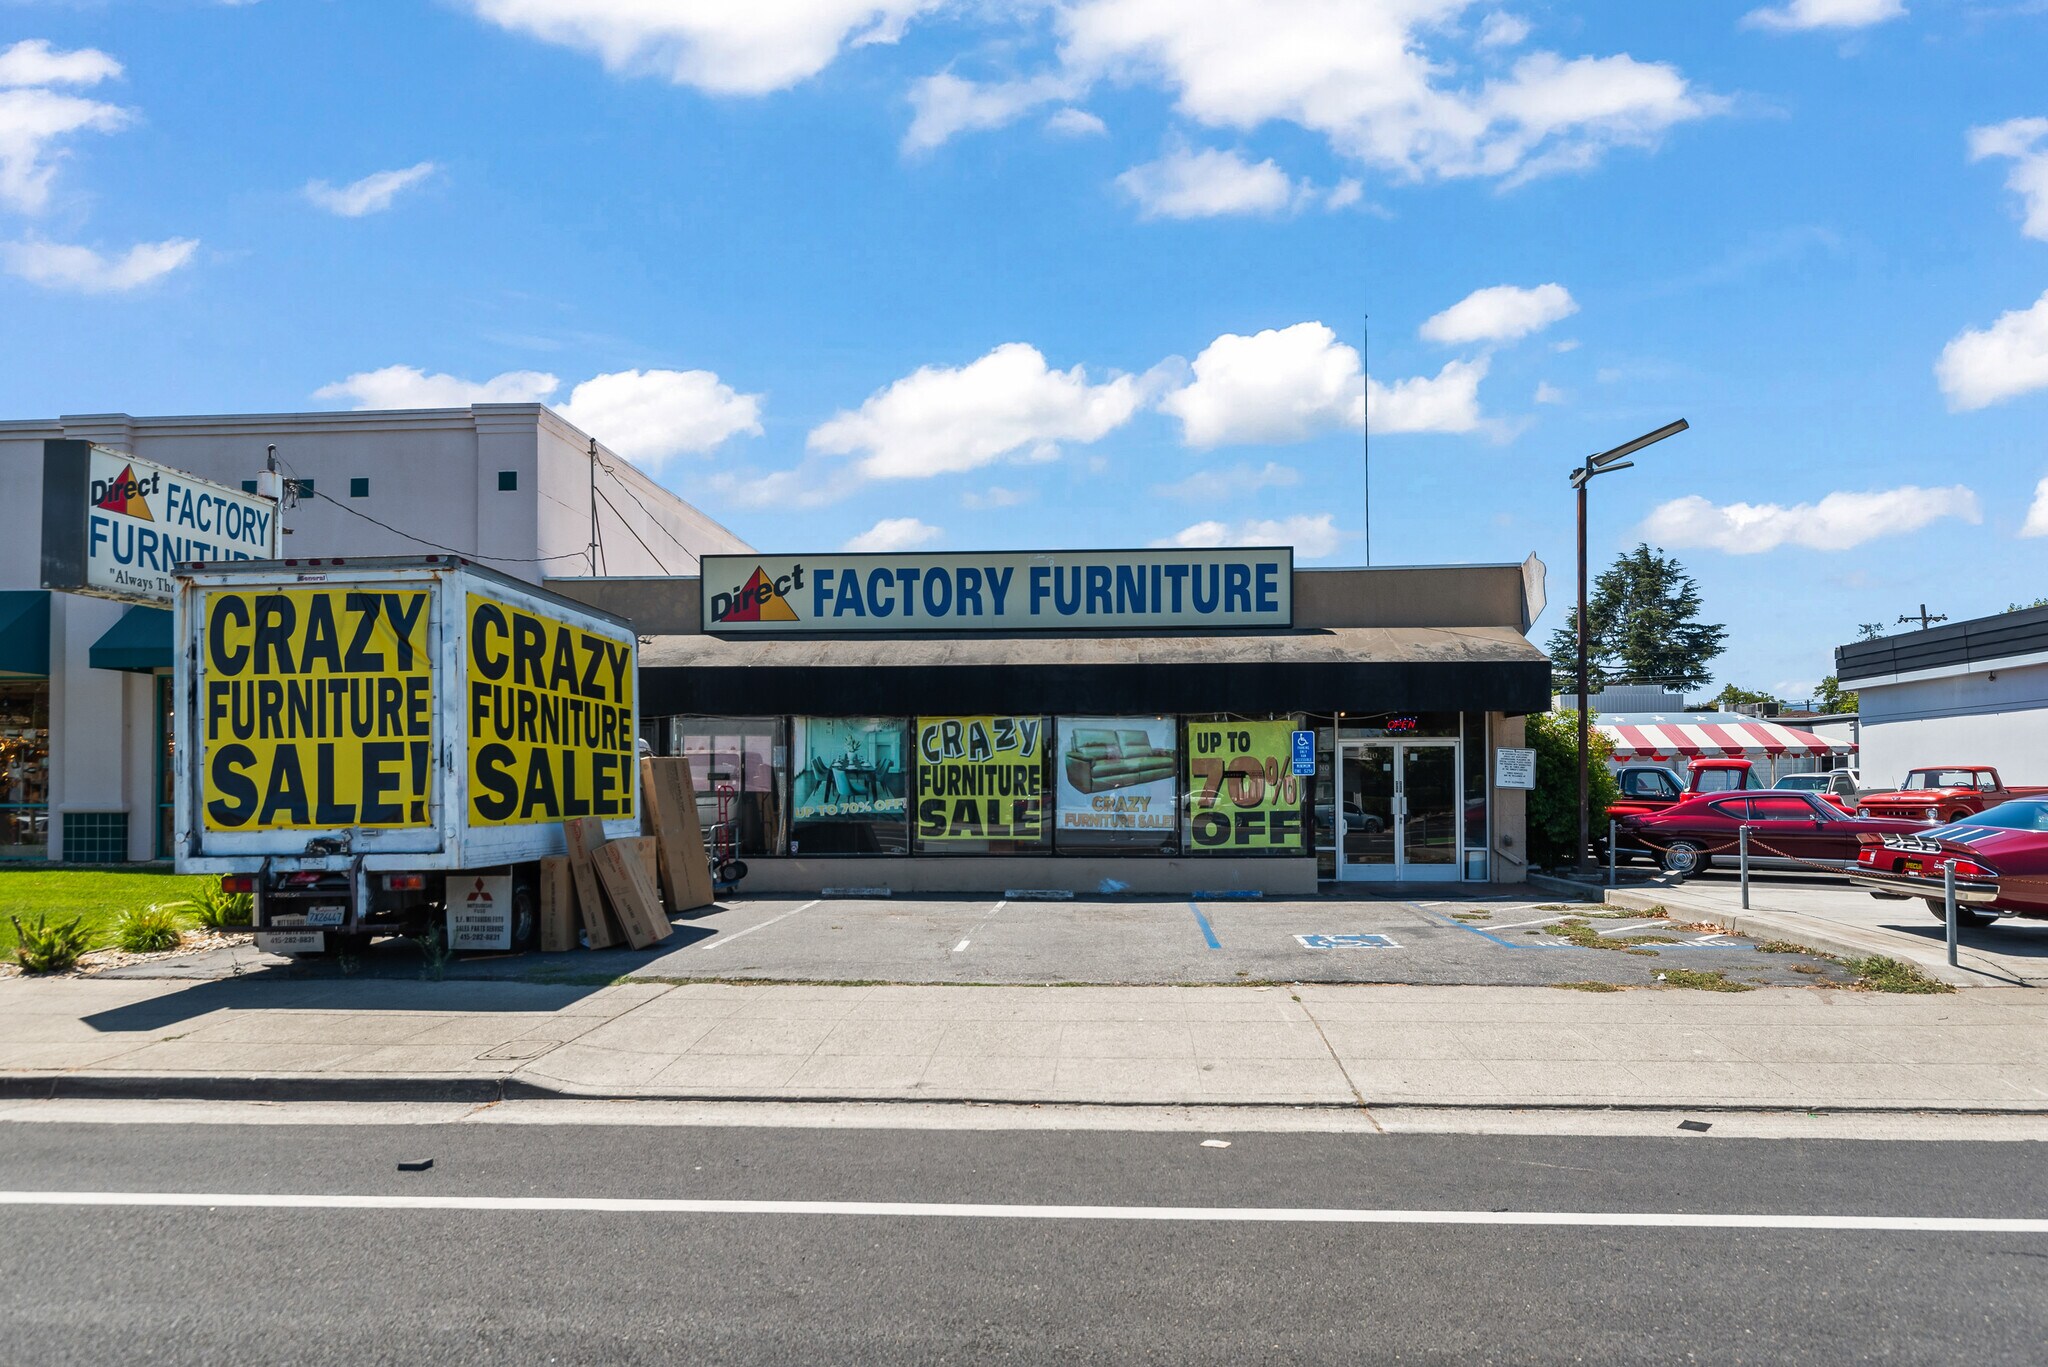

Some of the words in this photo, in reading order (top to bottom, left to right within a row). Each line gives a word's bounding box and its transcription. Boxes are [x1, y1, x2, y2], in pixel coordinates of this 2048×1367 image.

[91, 472, 160, 506] Direct
[166, 483, 270, 546] FACTORY
[90, 515, 268, 573] FURNIT
[711, 564, 804, 623] Direct
[813, 567, 1014, 617] FACTORY
[1030, 563, 1279, 614] FURNITURE
[210, 594, 427, 676] CRAZY
[472, 603, 630, 703] CRAZY
[209, 676, 429, 740] FURNITURE
[472, 681, 631, 751] FURNITURE
[1387, 720, 1415, 729] OPEN
[921, 717, 1040, 764] CRAZY
[1197, 732, 1222, 753] UP
[1227, 731, 1251, 752] TO
[207, 741, 429, 826] SALE!
[474, 746, 631, 821] SALE!
[920, 764, 1040, 796] FURNITURE
[1092, 796, 1151, 812] CRAZY
[1191, 756, 1296, 809] 70%
[795, 807, 815, 818] UP
[818, 804, 837, 816] TO
[840, 801, 872, 814] 70%
[920, 799, 1040, 836] SALE
[1065, 813, 1136, 828] FURNITURE
[1192, 810, 1300, 846] OFF
